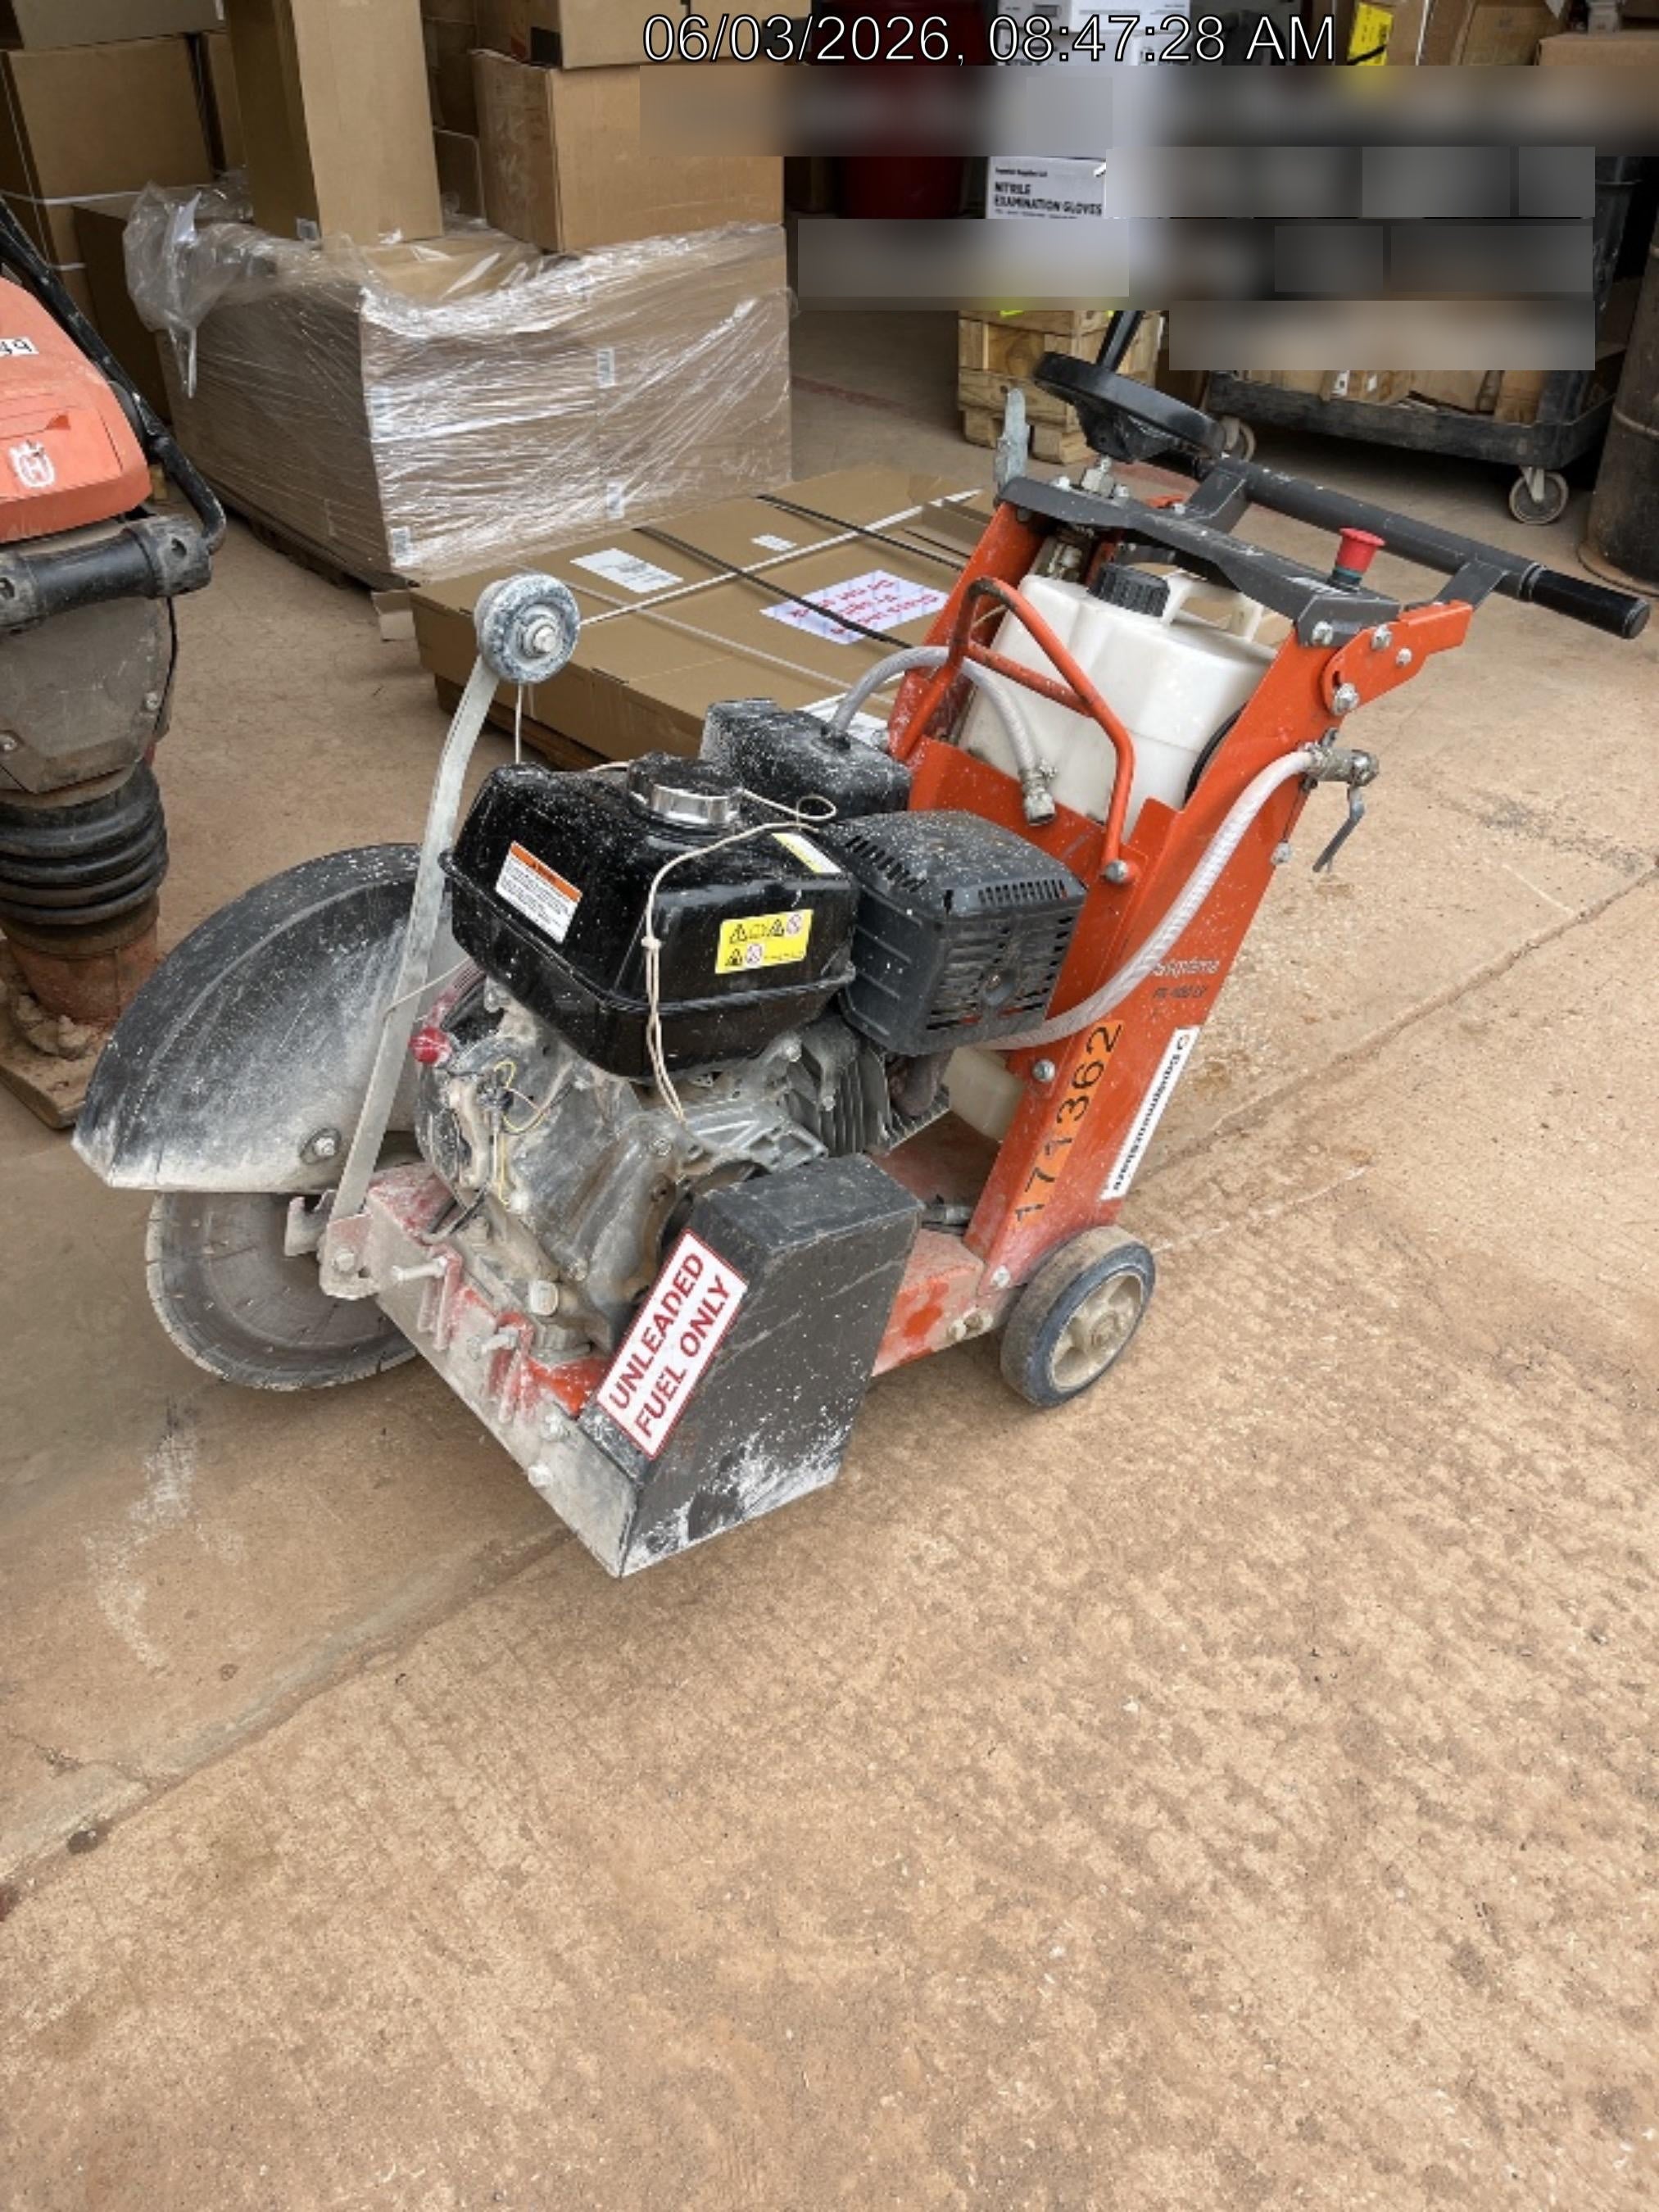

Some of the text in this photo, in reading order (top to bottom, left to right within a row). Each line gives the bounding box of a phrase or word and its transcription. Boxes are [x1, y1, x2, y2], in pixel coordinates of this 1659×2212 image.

[994, 182, 1031, 195] NITRILE
[994, 195, 1060, 212] EXAMINATION
[1063, 201, 1103, 216] GLOVES
[1014, 1024, 1122, 1222] 171362
[609, 1253, 704, 1410] UNLEADED
[634, 1275, 732, 1438] FUEL ONLY
